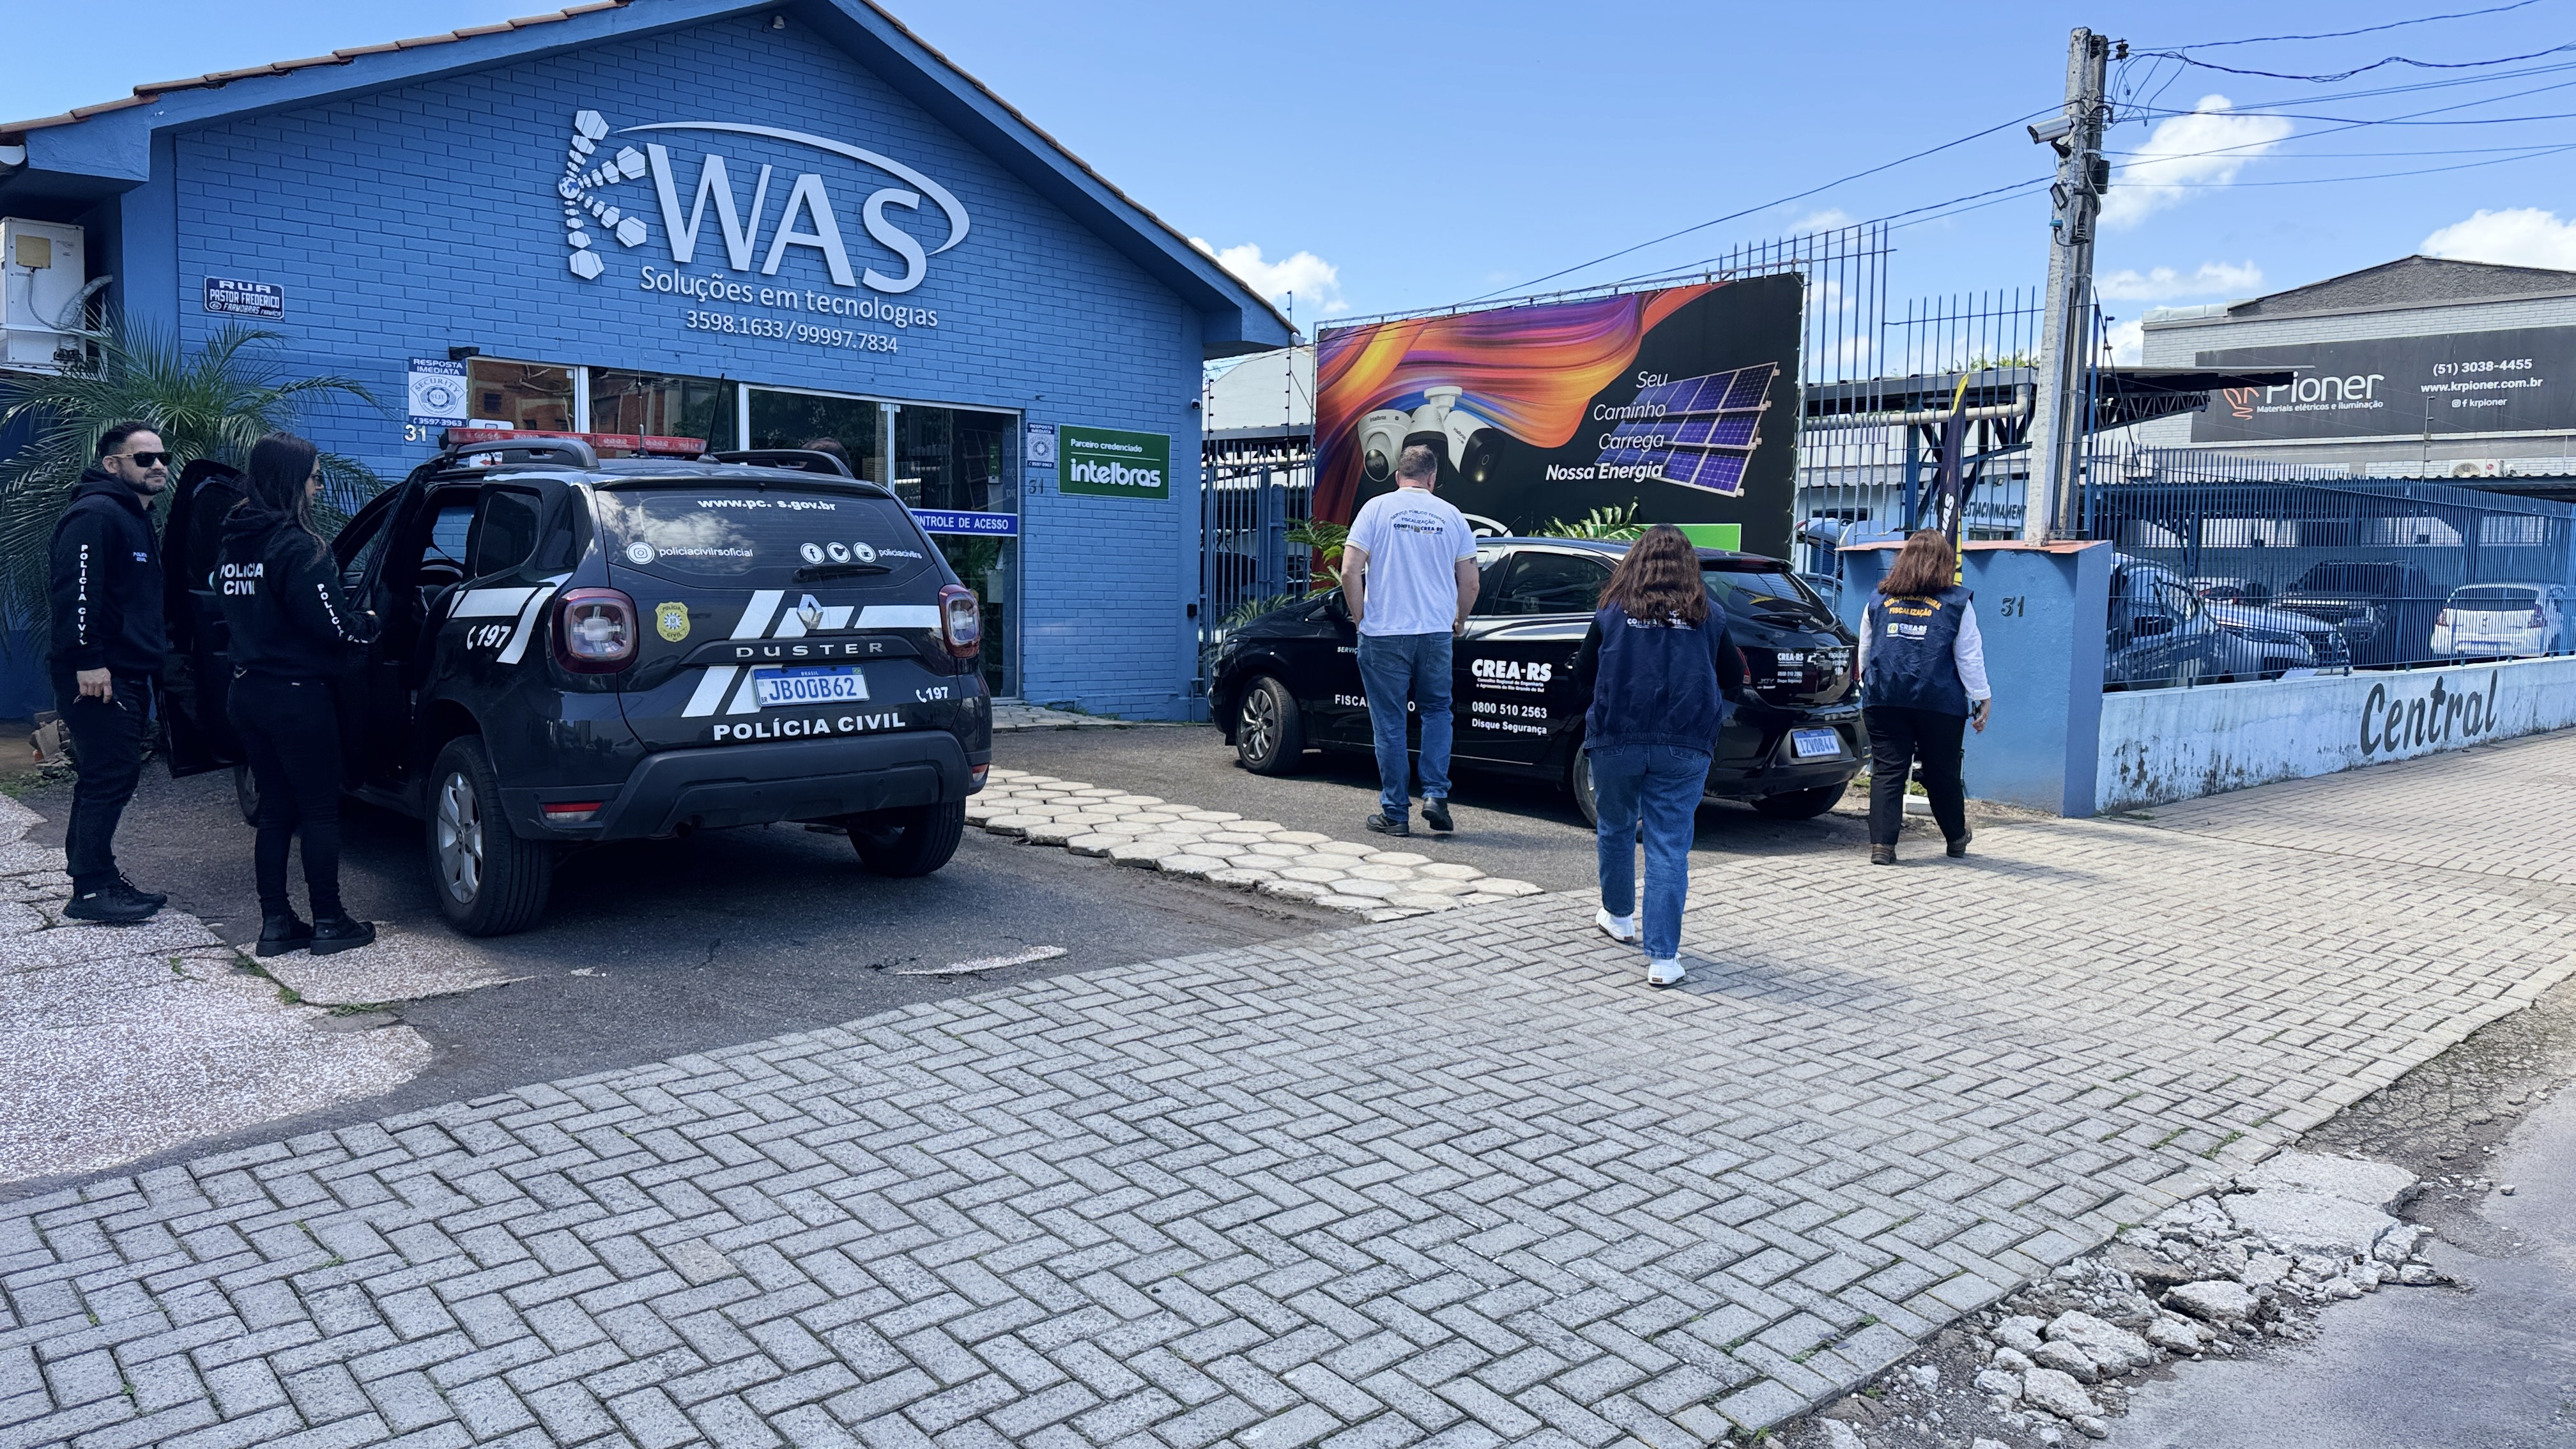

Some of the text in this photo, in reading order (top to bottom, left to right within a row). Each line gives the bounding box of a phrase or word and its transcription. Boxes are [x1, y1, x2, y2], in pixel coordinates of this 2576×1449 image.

[647, 143, 927, 293] WAS
[219, 280, 272, 294] RUA
[210, 288, 280, 309] PASTOR FREDERICO
[640, 265, 939, 328] Soluções em tecnologias
[413, 358, 463, 369] RESPOSTA
[417, 366, 460, 376] IMEDIATA
[2433, 358, 2533, 376] (51) 3038-4455
[415, 378, 461, 393] SECURITY
[1636, 371, 1669, 388] Seu
[2421, 377, 2543, 393] www.krpioner.com.br
[1593, 400, 1666, 420] Caminho
[2257, 404, 2294, 413] Materiais
[2294, 402, 2329, 412] elétricos
[2338, 400, 2384, 411] iluminação
[2469, 398, 2508, 409] krpioner
[404, 424, 427, 442] 31
[1070, 438, 1142, 453] Parceiro credenciado
[1598, 433, 1665, 453] Carrega
[1070, 458, 1162, 487] intelbras
[1545, 461, 1664, 483] Nossa Energia
[1028, 478, 1043, 494] 31
[958, 518, 970, 528] DE
[974, 518, 1009, 530] ACESSO
[659, 546, 753, 558] policiacivilrsoficial
[1889, 606, 1932, 618] FISCALIZAÇÃO
[2001, 595, 2025, 618] 31
[77, 607, 88, 645] CIVIL
[477, 624, 512, 648] 197
[736, 642, 884, 658] DUSTER
[1471, 659, 1552, 682] CREA-RS
[926, 686, 949, 700] 197
[1472, 701, 1547, 719] 0800 510 2563
[2360, 668, 2498, 756] Central
[714, 712, 906, 741] POLÍCIA CIVIL
[1471, 718, 1547, 735] Disque Segurança
